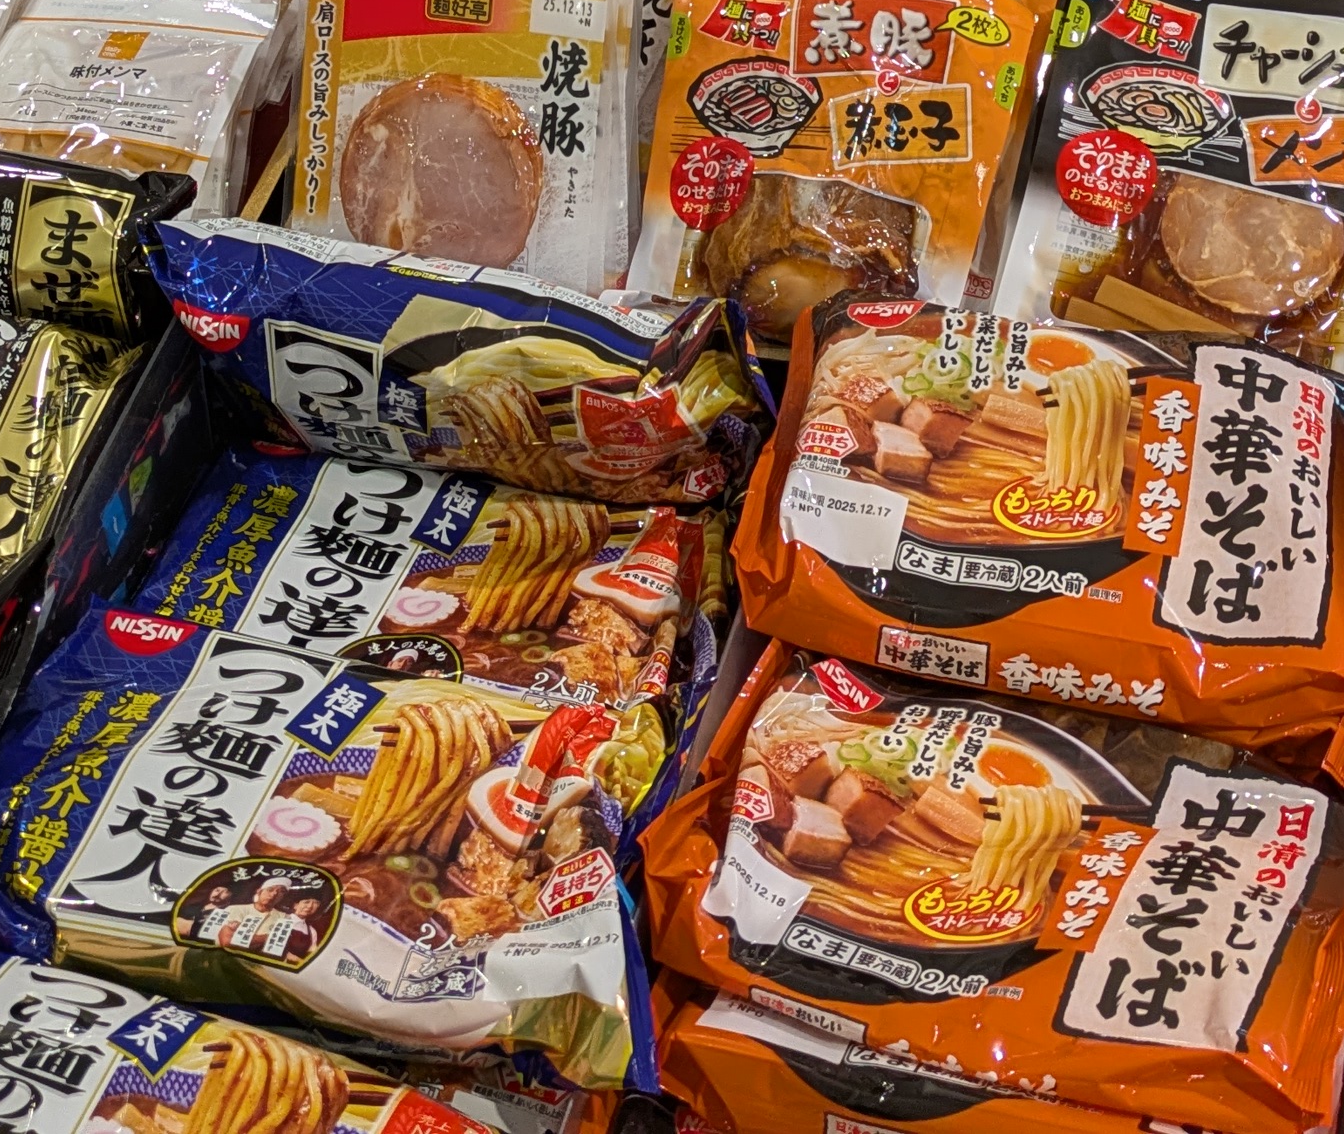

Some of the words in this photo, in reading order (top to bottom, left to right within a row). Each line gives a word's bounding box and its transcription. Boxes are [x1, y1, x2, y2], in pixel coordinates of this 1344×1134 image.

[804, 0, 934, 66] 煮豚
[540, 40, 589, 157] 焼豚
[844, 99, 960, 159] 煮玉子
[677, 184, 740, 200] のせるだけ!
[681, 155, 748, 180] そのまま
[1072, 141, 1150, 180] そのまま
[1069, 187, 1133, 215] おつまみにも
[1186, 356, 1290, 624] 中華そば
[1281, 380, 1326, 564] 日清のおいしい
[421, 481, 477, 547] 極太
[826, 498, 893, 518] 2025.12.17
[300, 683, 366, 748] 極太
[997, 653, 1166, 716] 香味みそ
[912, 706, 965, 780] 野菜だしが
[949, 713, 1002, 791] 豚の旨みと
[71, 662, 293, 902] つけ麺の達人
[915, 886, 1022, 915] もっちり
[926, 909, 1025, 929] ストレート麺
[1096, 789, 1267, 1029] 中華そば
[854, 949, 915, 984] 要冷蔵
[918, 969, 986, 997] 2人前
